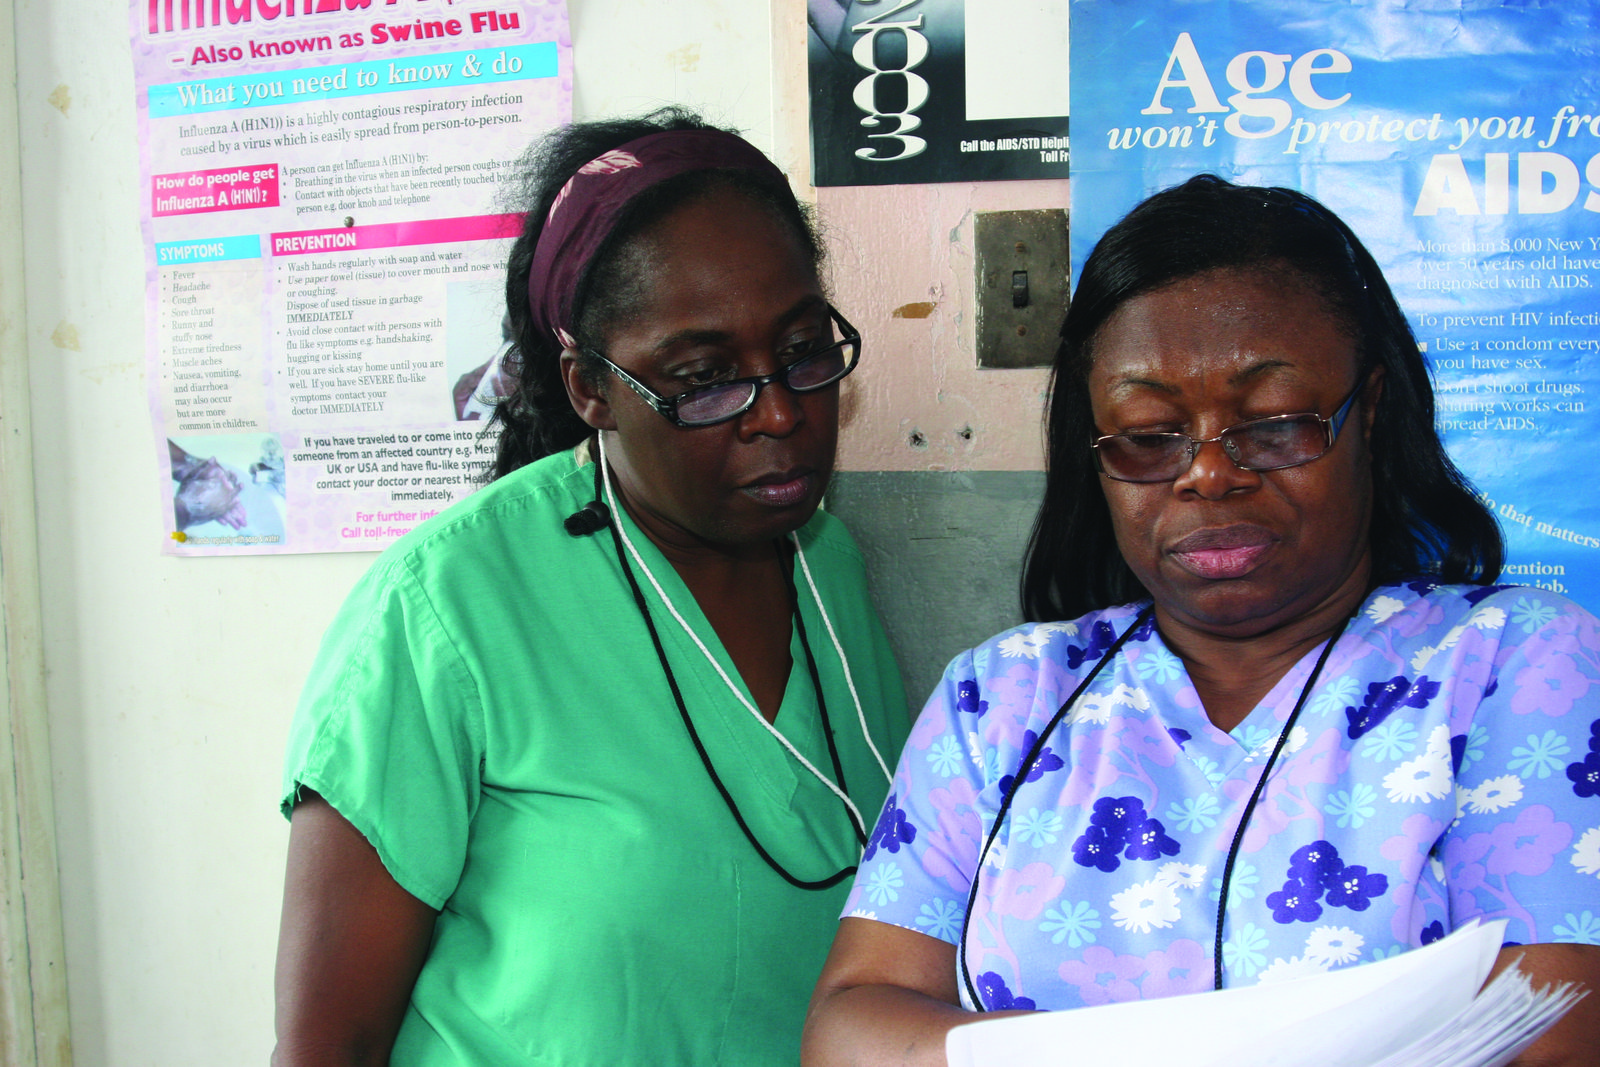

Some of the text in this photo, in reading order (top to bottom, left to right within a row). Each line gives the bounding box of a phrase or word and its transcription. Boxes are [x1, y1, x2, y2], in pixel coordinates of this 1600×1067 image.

[191, 10, 520, 66] Also known as Swine Flu
[177, 51, 523, 107] What you need to know & do
[1140, 32, 1352, 139] Age
[179, 93, 523, 138] Influenza A (H1N1)) is a highly contagious respiratory infection
[180, 113, 522, 156] caused by a virus which is easily spread from person-to-person.
[1107, 115, 1219, 150] won't
[1282, 113, 1444, 154] protect
[1448, 116, 1535, 150] you
[960, 136, 1070, 152] Call the AIDS/STD Helpli
[281, 166, 288, 176] A
[289, 165, 316, 178] person
[317, 163, 331, 173] can
[332, 162, 344, 174] get
[345, 155, 380, 170] Influenza
[382, 155, 388, 166] A
[389, 152, 415, 167] (H1N1)
[1040, 151, 1058, 163] Toll
[156, 168, 275, 190] How do people get
[295, 175, 333, 190] Breathing
[335, 175, 343, 184] in
[344, 173, 356, 183] the
[358, 170, 377, 182] virus
[379, 169, 399, 179] when
[400, 169, 410, 177] an
[411, 164, 442, 177] infected
[444, 163, 470, 175] person
[472, 159, 500, 171] coughs
[156, 195, 215, 212] Influenza
[217, 191, 229, 206] A
[275, 232, 357, 252] PREVENTION
[1418, 240, 1456, 253] More
[1462, 239, 1495, 252] than
[1500, 238, 1542, 254] 8,000
[1547, 237, 1584, 251] New
[160, 242, 225, 261] SYMPTOMS
[288, 251, 462, 272] Wash hands regularly with soap and water
[1417, 260, 1451, 271] over
[1460, 257, 1477, 271] 50
[1483, 259, 1525, 275] years
[1530, 256, 1556, 270] old
[173, 270, 195, 280] Fever
[1417, 274, 1593, 293] diagnosed with AIDS.
[173, 281, 211, 292] Headache
[172, 295, 197, 304] Cough
[287, 310, 354, 323] IMMEDIATELY
[1417, 311, 1600, 330] To prevent HIV infecti
[1435, 338, 1465, 351] Use
[1471, 341, 1480, 351] a
[1486, 336, 1552, 351] condom
[1435, 355, 1547, 373] you have sex.
[1485, 379, 1529, 393] shoot
[1535, 379, 1585, 397] drugs.
[1501, 398, 1550, 412] works
[1556, 401, 1584, 412] can
[179, 423, 211, 431] common
[213, 420, 221, 429] in
[1434, 416, 1539, 434] spread AIDS.
[304, 437, 311, 447] If
[313, 438, 330, 449] you
[333, 435, 355, 446] have
[357, 433, 396, 445] traveled
[397, 433, 409, 443] to
[411, 434, 422, 443] or
[424, 433, 451, 442] come
[453, 430, 472, 440] into
[293, 443, 495, 461] someone from an affected country e.g. Mex
[327, 464, 342, 474] UK
[344, 465, 355, 473] or
[357, 462, 378, 473] USA
[381, 462, 398, 473] and
[401, 461, 423, 471] have
[426, 460, 458, 470] flu-like
[317, 479, 350, 489] contact
[353, 480, 374, 490] your
[377, 477, 408, 487] doctor
[411, 477, 422, 486] or
[424, 475, 460, 486] nearest
[391, 489, 454, 502] immediately.
[356, 509, 439, 522] For further inf
[1500, 504, 1534, 527] that
[341, 527, 361, 538] Call
